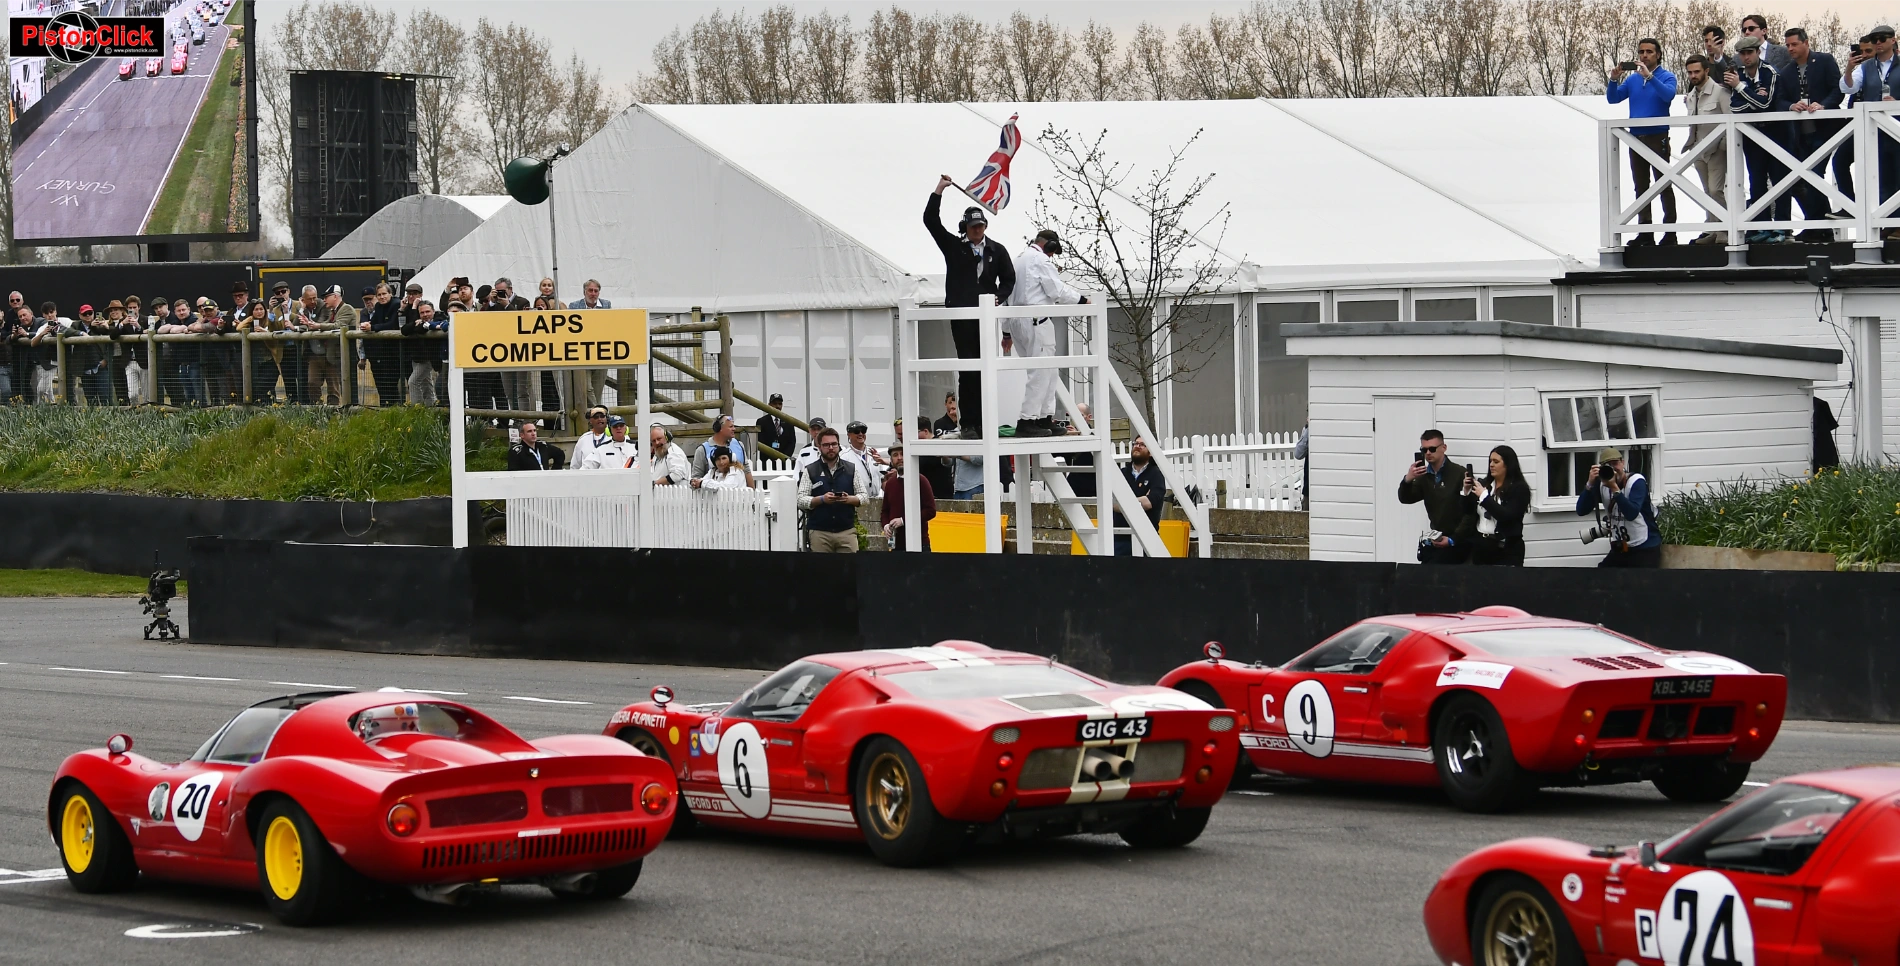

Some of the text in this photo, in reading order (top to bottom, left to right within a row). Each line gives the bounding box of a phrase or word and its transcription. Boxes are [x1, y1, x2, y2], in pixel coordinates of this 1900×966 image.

[517, 314, 584, 335] LAPS
[471, 340, 630, 363] COMPLETED
[1653, 679, 1712, 695] XBL 345E
[1081, 719, 1147, 739] GIG 43
[1262, 693, 1318, 745] C 9
[1258, 737, 1288, 748] FORD
[733, 738, 752, 798] 6
[177, 783, 211, 820] 20
[693, 798, 711, 811] FORD
[1639, 888, 1743, 966] P 74
